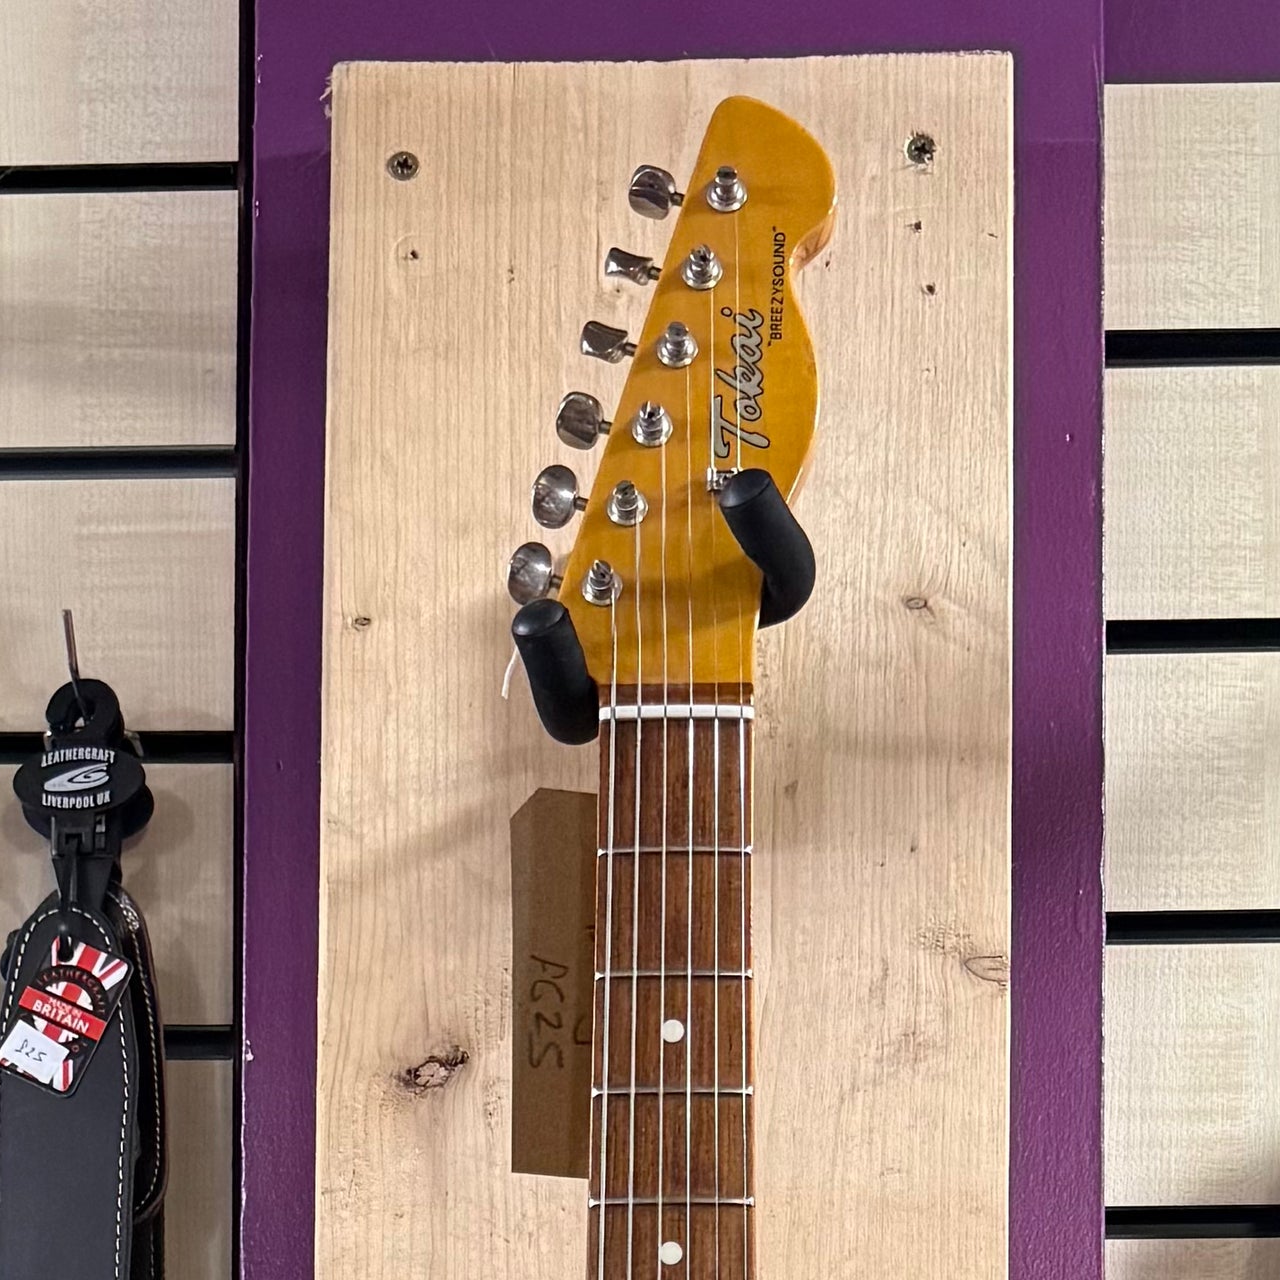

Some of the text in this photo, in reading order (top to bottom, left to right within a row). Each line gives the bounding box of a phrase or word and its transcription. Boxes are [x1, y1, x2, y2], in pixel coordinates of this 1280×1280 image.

[712, 307, 770, 458] Tokai
[41, 747, 115, 767] LEATHERCRAFT
[42, 790, 111, 808] LIVERPOOL UK
[33, 1000, 89, 1034] BRITAIN
